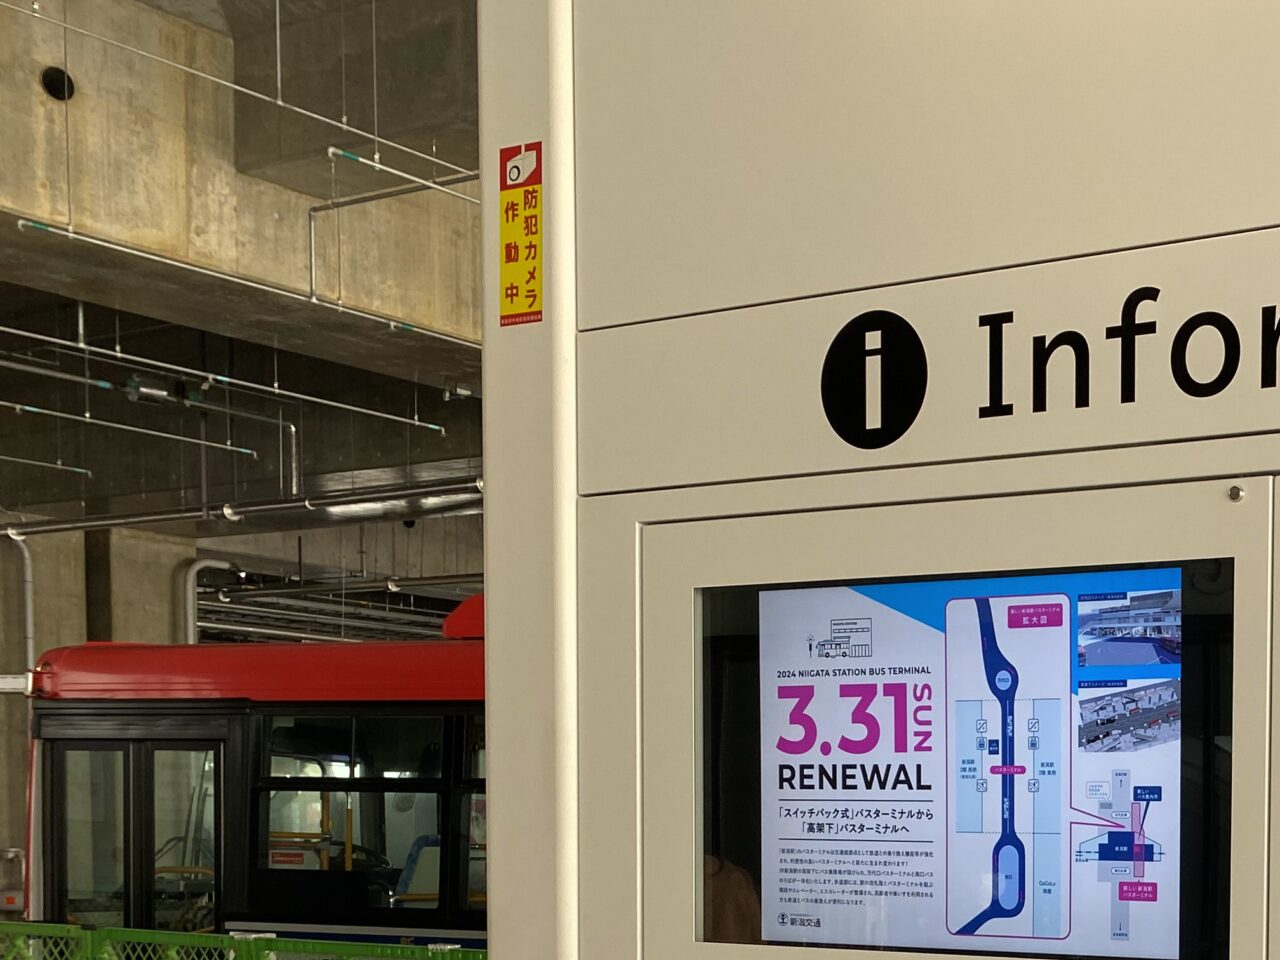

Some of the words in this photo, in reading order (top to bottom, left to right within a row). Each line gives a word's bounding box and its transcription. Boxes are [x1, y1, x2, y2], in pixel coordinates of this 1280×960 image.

[504, 200, 520, 304] 作動中
[523, 187, 538, 309] 防犯カメラ
[1022, 616, 1048, 625] 拡大図
[777, 670, 796, 678] 2024
[798, 669, 830, 677] NIIGATA
[832, 668, 866, 676] STATION
[868, 667, 886, 675] BUS
[888, 666, 931, 675] TERMINAL
[776, 683, 908, 756] 3.31
[912, 683, 932, 752] SUN
[778, 764, 932, 790] RENEWAL
[779, 806, 934, 820] 「スイッチバック式」バスターミナルから
[802, 822, 910, 834] 「高架下」バスターミナルへ
[790, 918, 821, 928] 新潟交通
